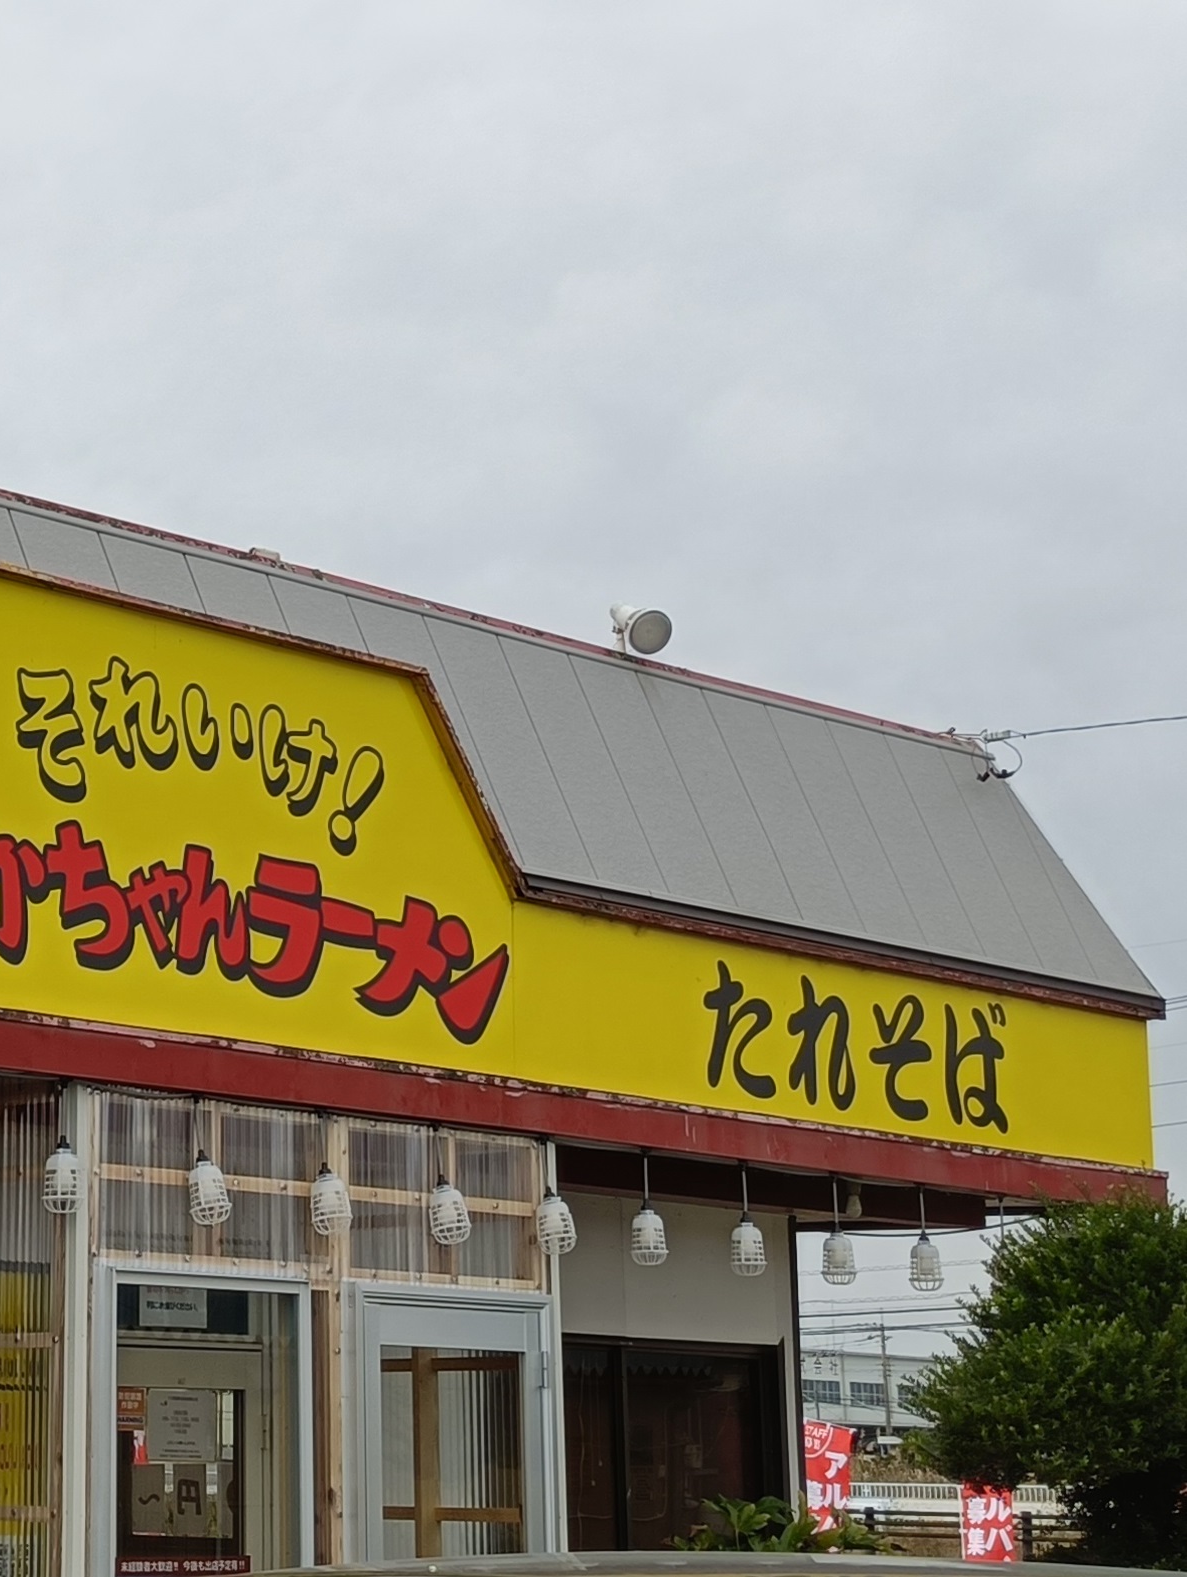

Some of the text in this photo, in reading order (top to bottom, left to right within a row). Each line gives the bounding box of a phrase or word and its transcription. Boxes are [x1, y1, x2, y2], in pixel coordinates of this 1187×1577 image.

[16, 655, 384, 856] それいけ!
[703, 959, 1008, 1134] たれそば
[965, 1496, 987, 1556] 募集
[985, 1496, 1014, 1562] ルバ
